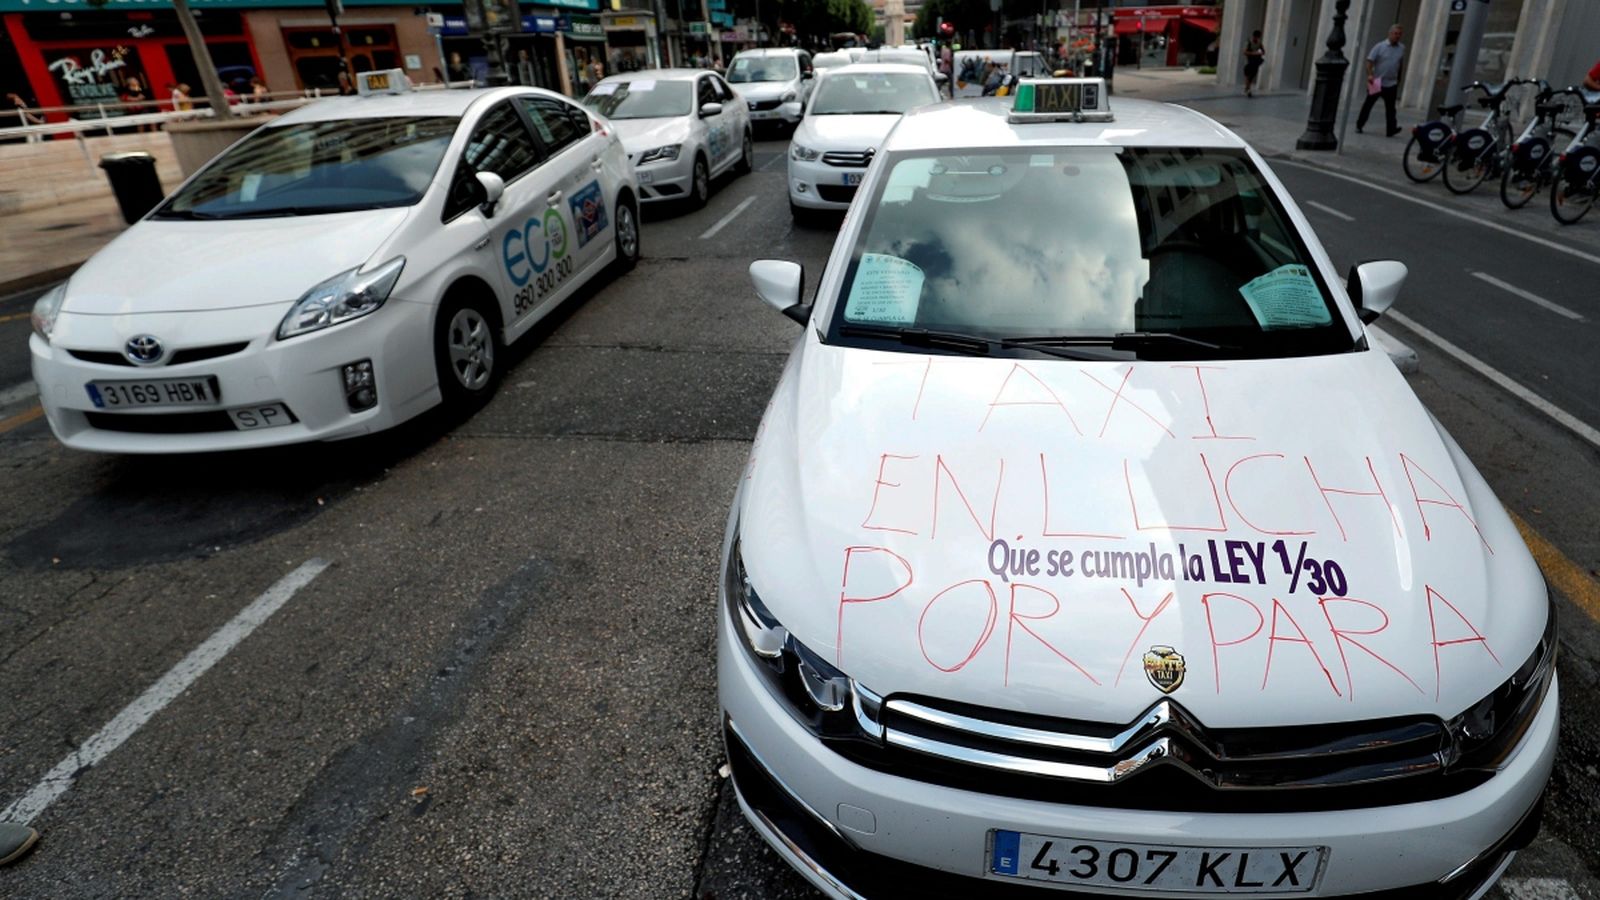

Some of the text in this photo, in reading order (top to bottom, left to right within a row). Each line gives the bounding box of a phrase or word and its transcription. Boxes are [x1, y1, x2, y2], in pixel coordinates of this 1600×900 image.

[367, 74, 389, 90] TAXI
[1039, 84, 1079, 109] TAXI
[514, 254, 573, 315] 960 300 300
[104, 382, 208, 405] 3169 HBW
[872, 357, 1256, 440] TAXI
[861, 454, 1003, 541] EN
[988, 538, 1348, 597] Que se cumpla la LEY 1/30
[837, 546, 1502, 702] POR Y PARA
[1157, 670, 1173, 679] TAXI
[1030, 841, 1177, 884] 4307
[1196, 851, 1308, 888] KLX
